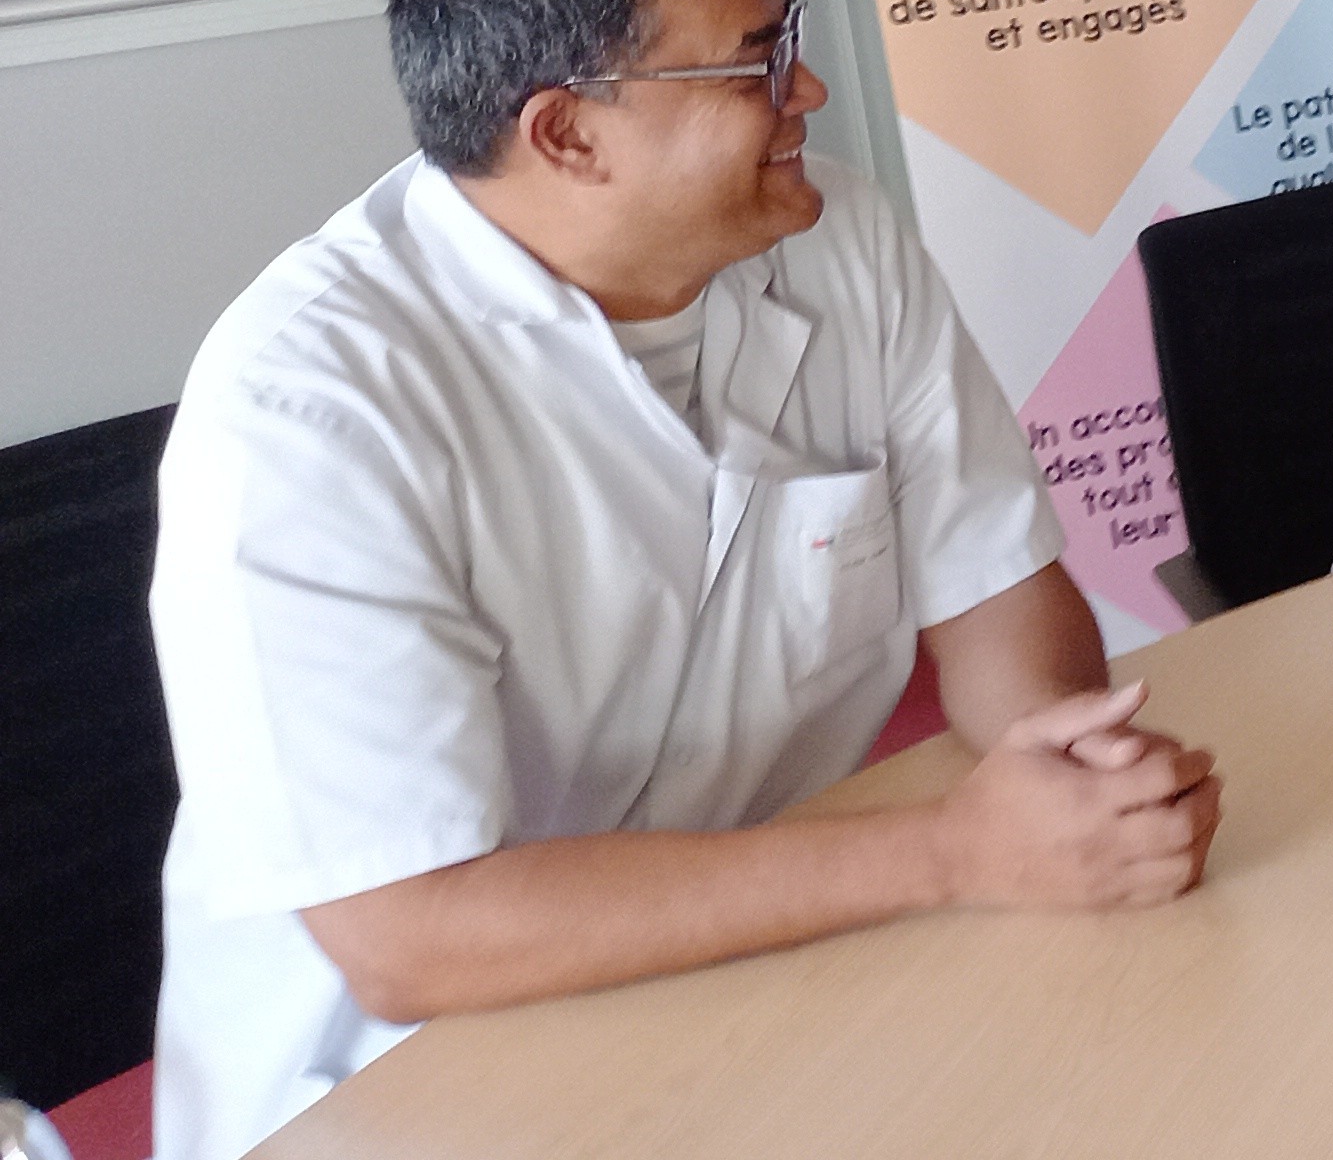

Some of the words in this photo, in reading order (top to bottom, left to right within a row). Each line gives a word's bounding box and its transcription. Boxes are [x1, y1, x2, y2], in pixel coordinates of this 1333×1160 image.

[985, 17, 1025, 52] et
[1232, 103, 1274, 135] Le
[1276, 130, 1317, 162] de
[1043, 453, 1107, 486] des
[1115, 432, 1173, 477] pro
[1081, 470, 1156, 518] tout
[1109, 510, 1180, 551] leur
